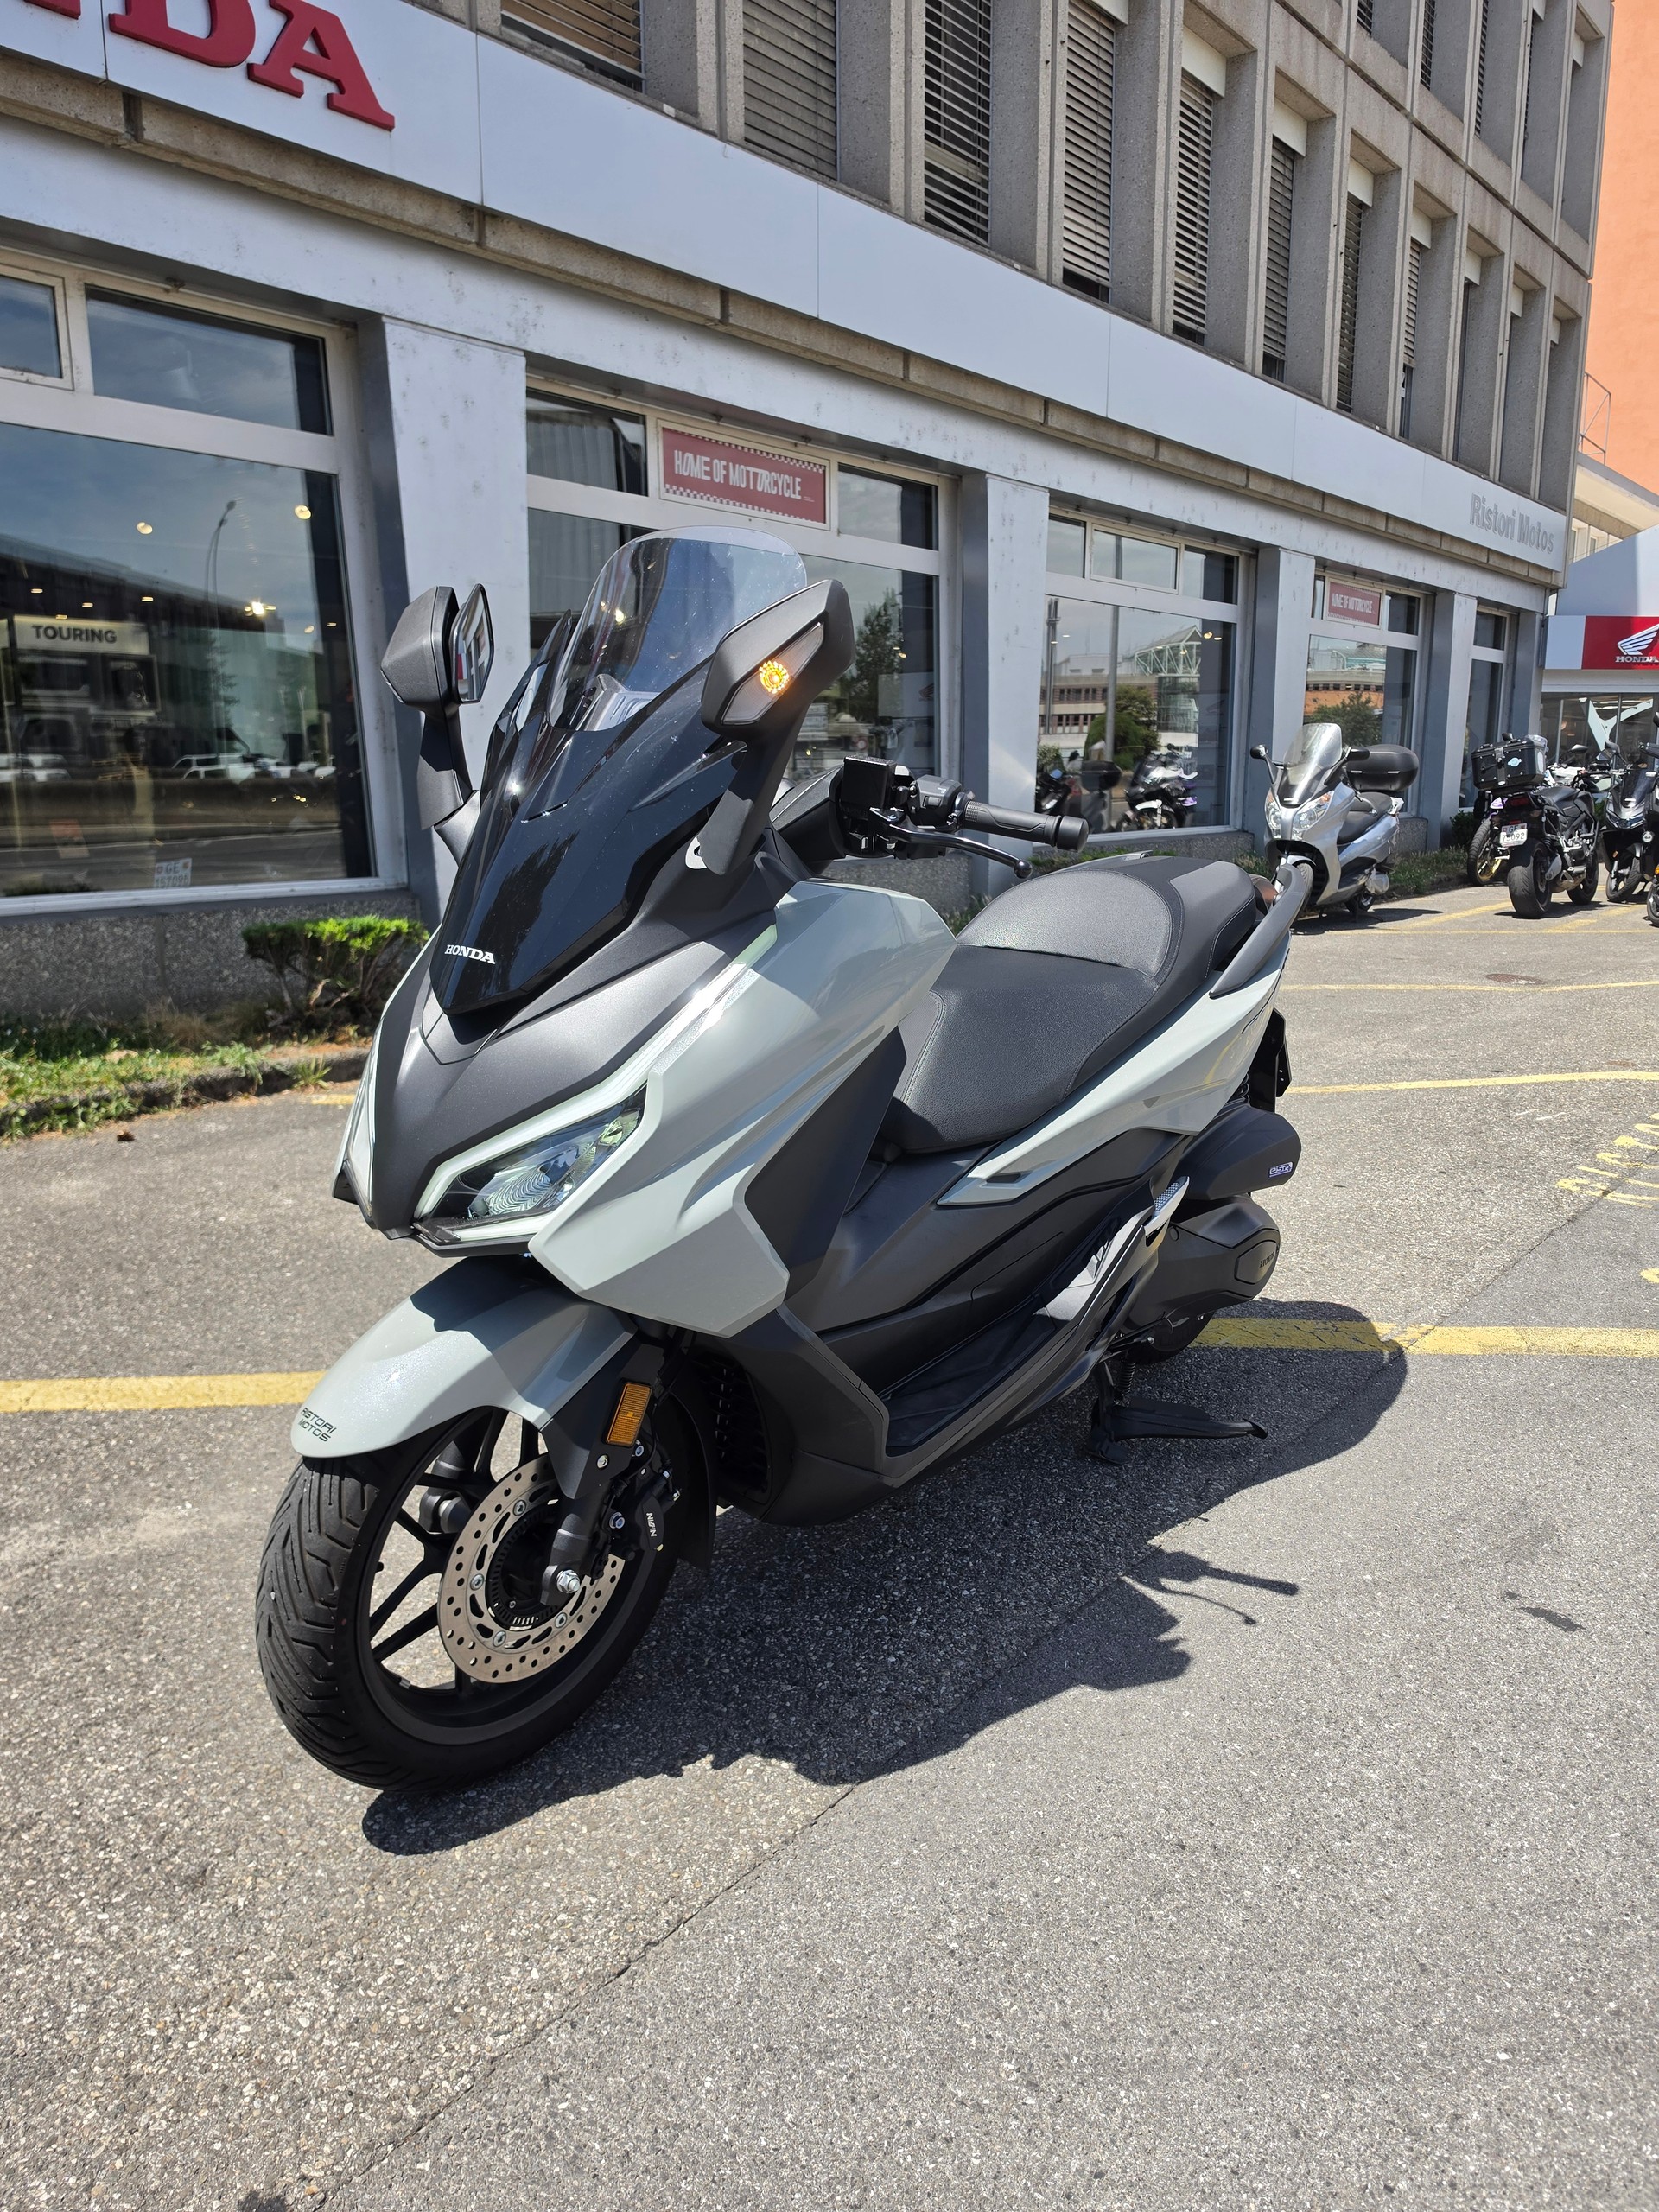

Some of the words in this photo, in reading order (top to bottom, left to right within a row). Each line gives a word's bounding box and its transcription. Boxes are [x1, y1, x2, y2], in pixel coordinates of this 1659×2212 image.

[713, 458, 728, 484] OF
[1470, 493, 1516, 541] Ristori
[1516, 512, 1554, 554] Motos
[32, 625, 118, 644] TOURING
[1503, 832, 1525, 842] 75092
[444, 944, 496, 965] HONDA
[298, 1418, 332, 1442] MOTOS
